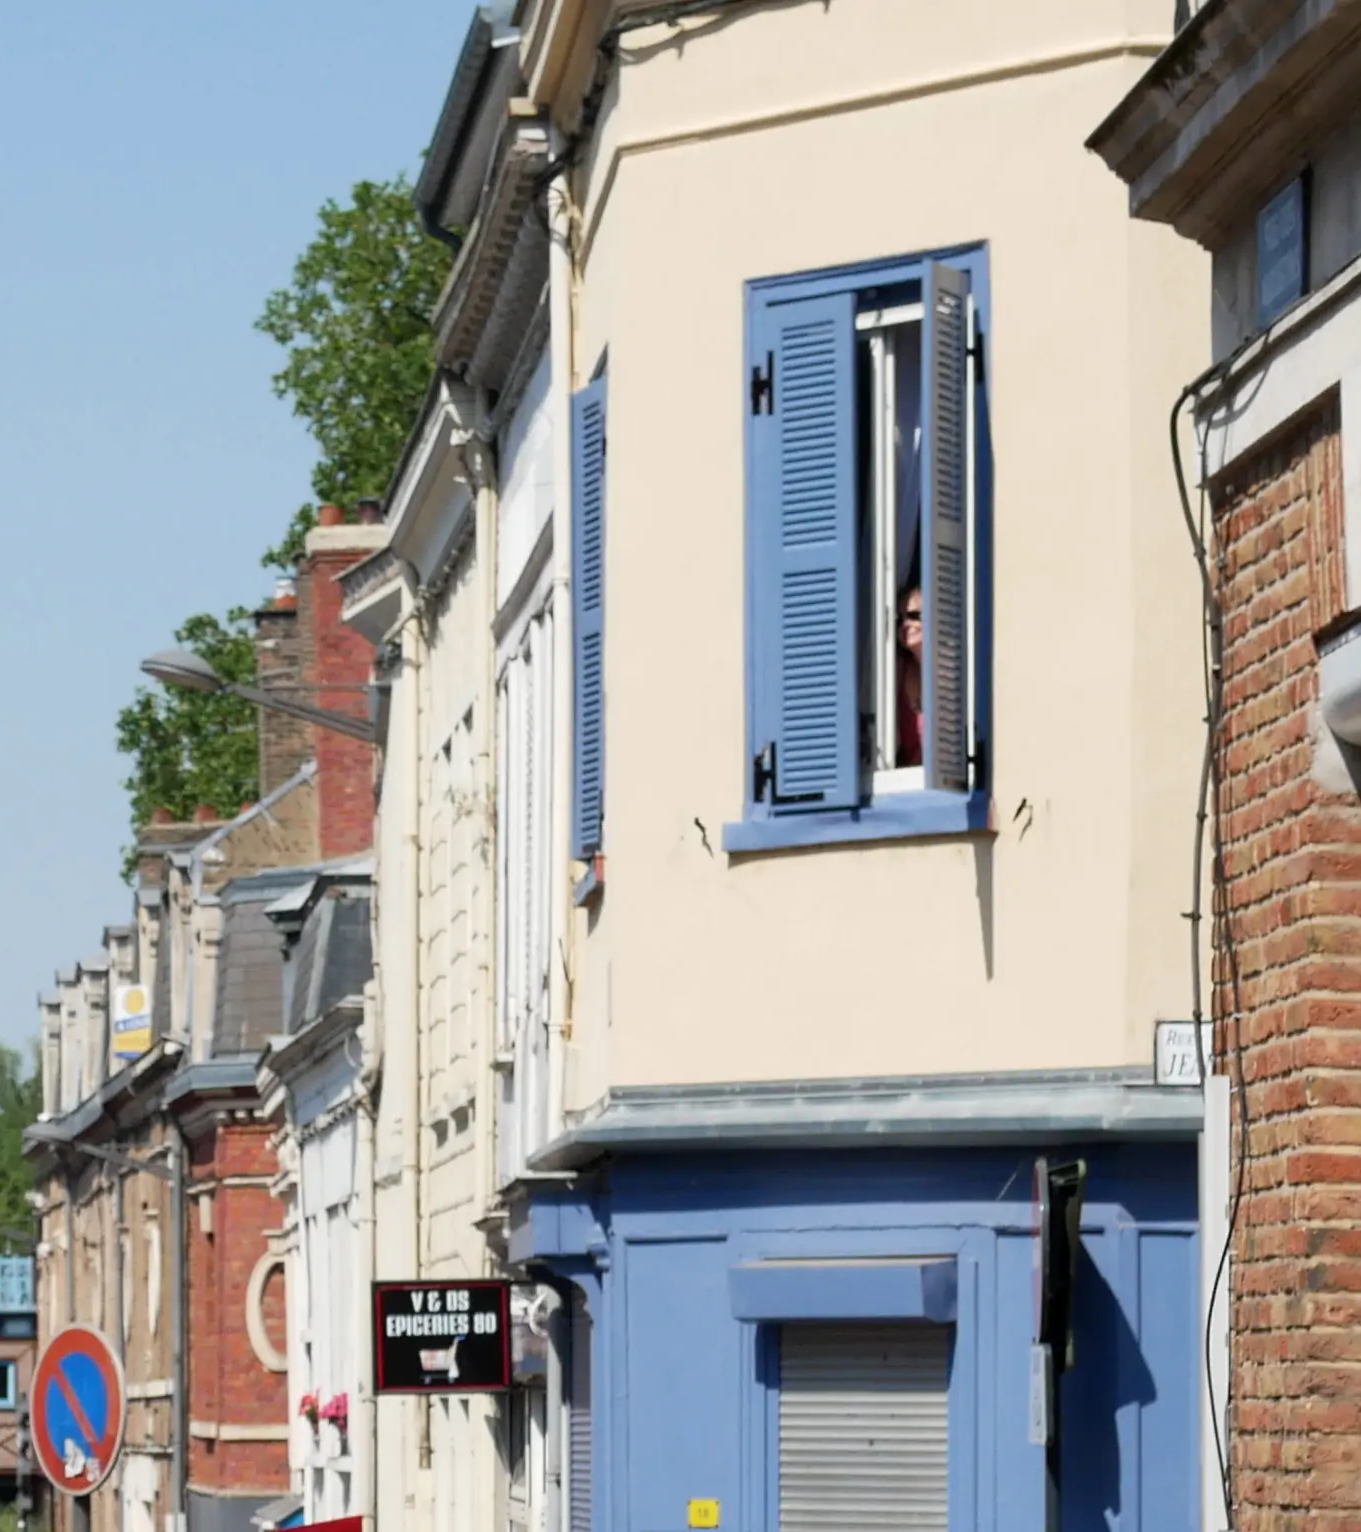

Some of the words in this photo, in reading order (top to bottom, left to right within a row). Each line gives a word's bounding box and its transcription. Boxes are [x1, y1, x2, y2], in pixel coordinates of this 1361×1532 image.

[410, 1291, 424, 1313] V
[427, 1290, 441, 1312] &
[385, 1313, 470, 1337] EPICERIES
